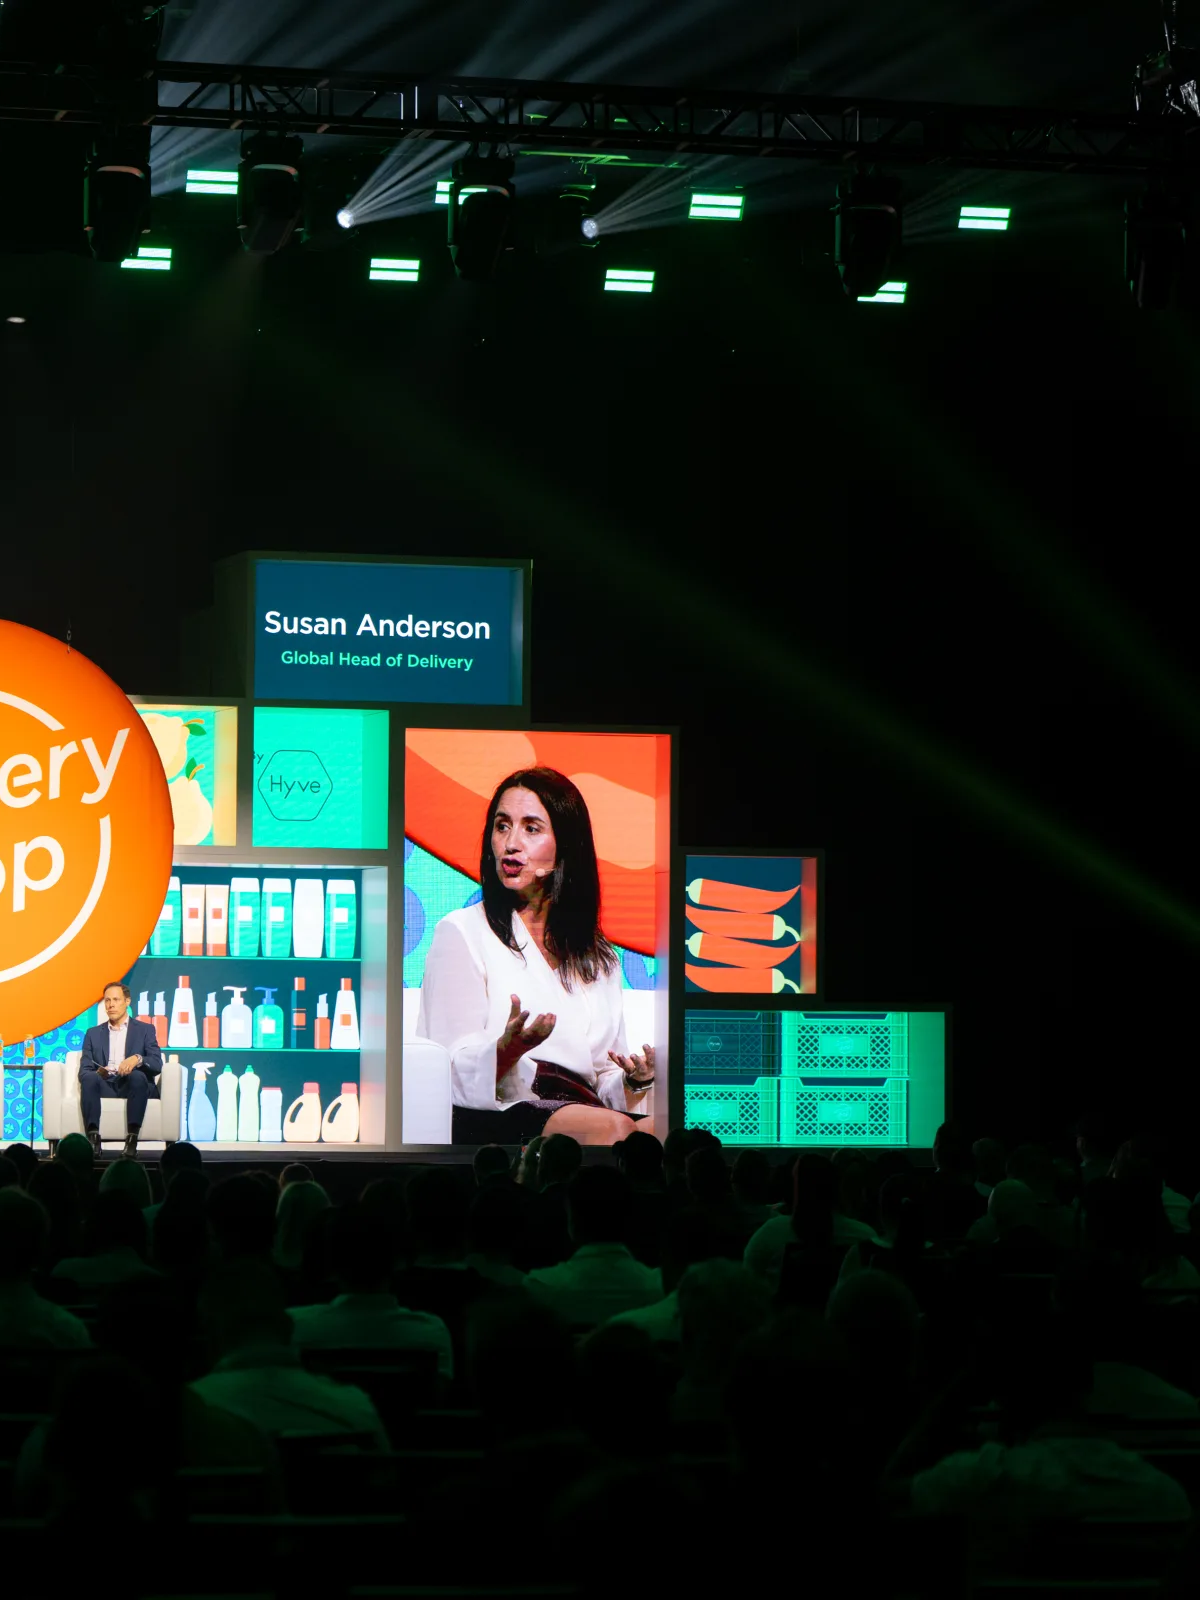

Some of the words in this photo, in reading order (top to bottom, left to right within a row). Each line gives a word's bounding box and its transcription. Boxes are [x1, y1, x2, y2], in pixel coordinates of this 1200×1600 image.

[264, 610, 346, 636] Susan
[356, 613, 491, 640] Anderson
[281, 651, 334, 665] Global
[339, 652, 381, 667] Head
[386, 653, 403, 667] of
[407, 654, 473, 671] Delivery
[270, 774, 321, 799] Hyve
